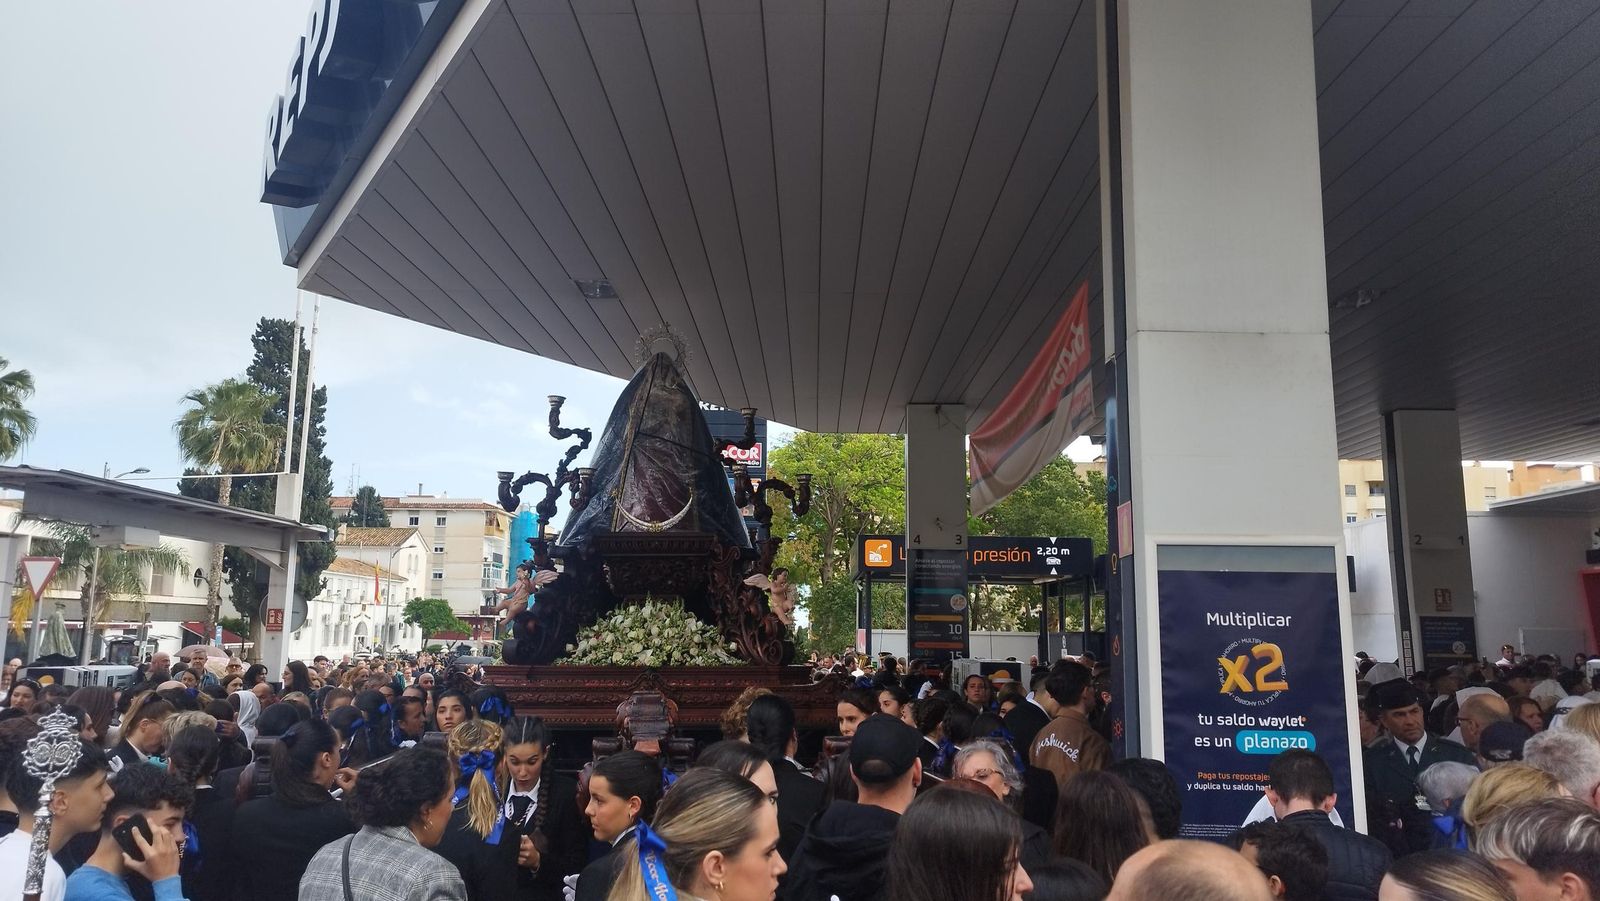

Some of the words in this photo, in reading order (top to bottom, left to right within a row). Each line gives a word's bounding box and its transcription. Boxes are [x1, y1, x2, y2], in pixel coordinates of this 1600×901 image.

[913, 534, 921, 545] 4
[955, 534, 962, 545] 3
[1414, 534, 1422, 545] 2
[1458, 535, 1464, 546] 1
[973, 547, 1031, 566] presión
[1037, 547, 1058, 556] 2,20
[1061, 548, 1070, 556] m
[1206, 611, 1292, 630] Multiplicar
[948, 623, 962, 635] 10
[1197, 713, 1213, 725] tu
[1217, 713, 1255, 726] saldo
[1258, 715, 1305, 730] waylet
[1194, 736, 1211, 747] es
[1214, 737, 1232, 747] un
[1244, 733, 1308, 752] planazo
[1197, 772, 1217, 781] Paga
[1218, 772, 1231, 780] tus
[1187, 783, 1192, 791] y
[1193, 782, 1221, 791] duplica
[1232, 783, 1254, 791] saldo
